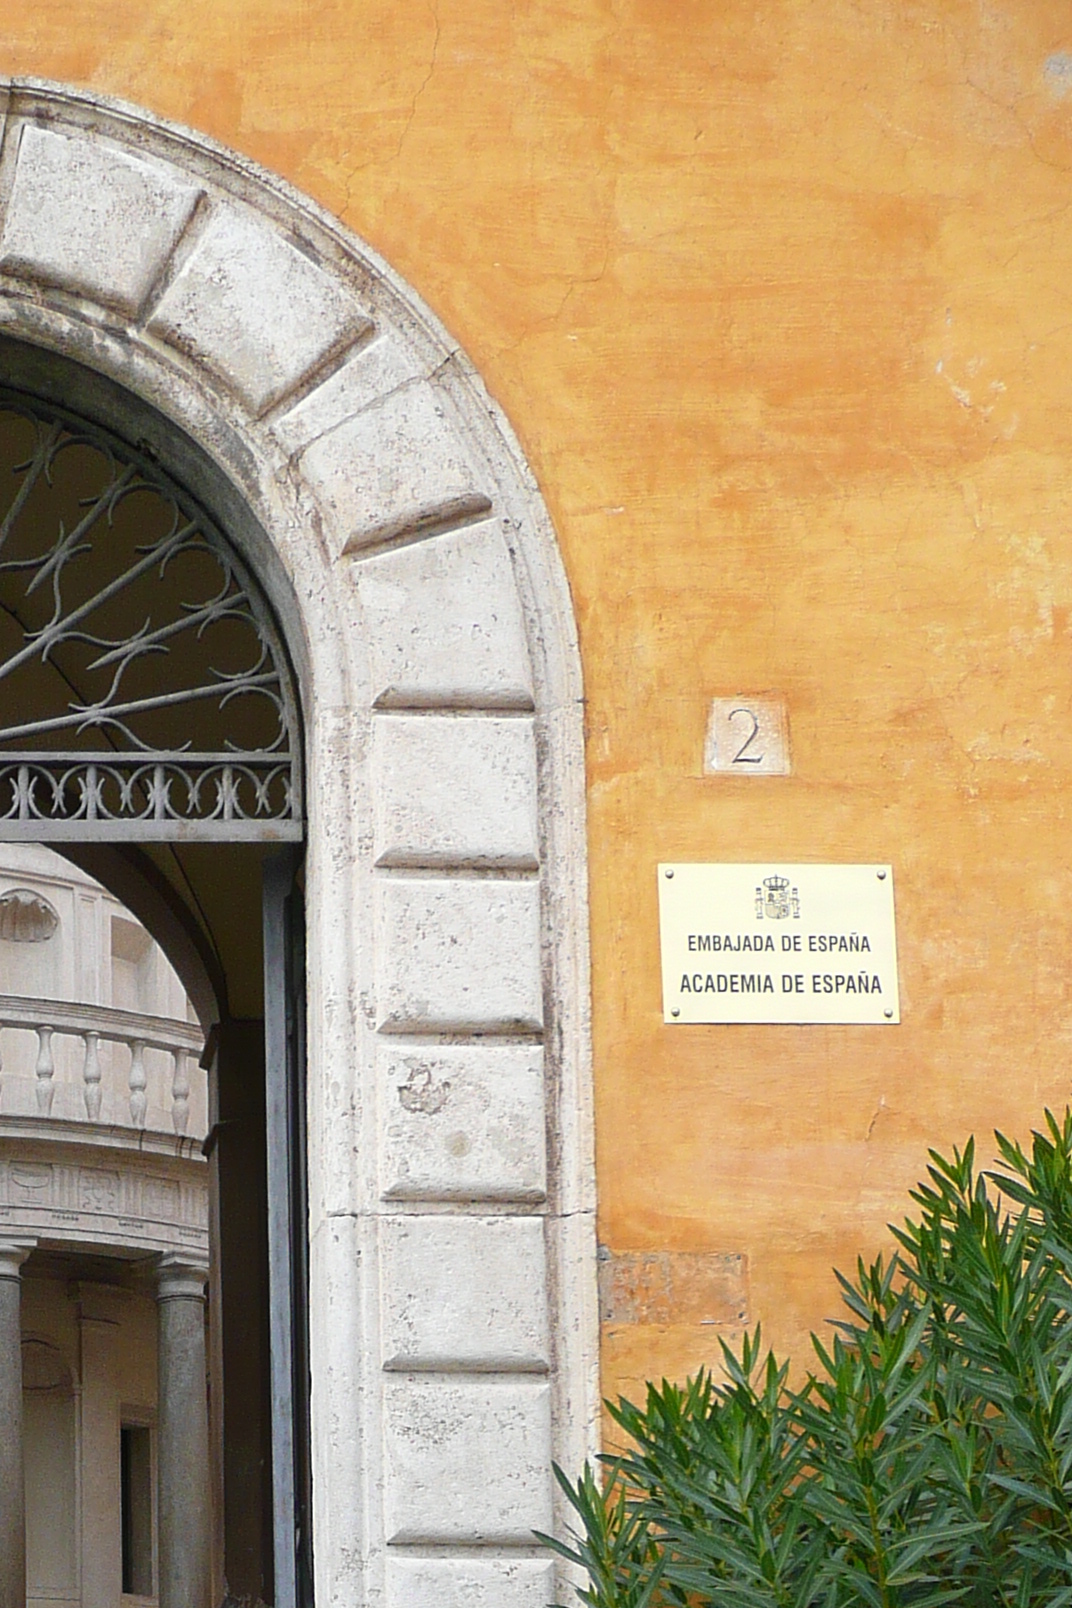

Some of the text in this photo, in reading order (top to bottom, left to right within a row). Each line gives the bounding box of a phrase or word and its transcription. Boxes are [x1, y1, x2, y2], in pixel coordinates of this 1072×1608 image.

[728, 708, 764, 763] 2
[688, 932, 871, 952] EMBAJADA DE ESPAÑA
[680, 970, 883, 994] ACADEMIA DE ESPAÑA
